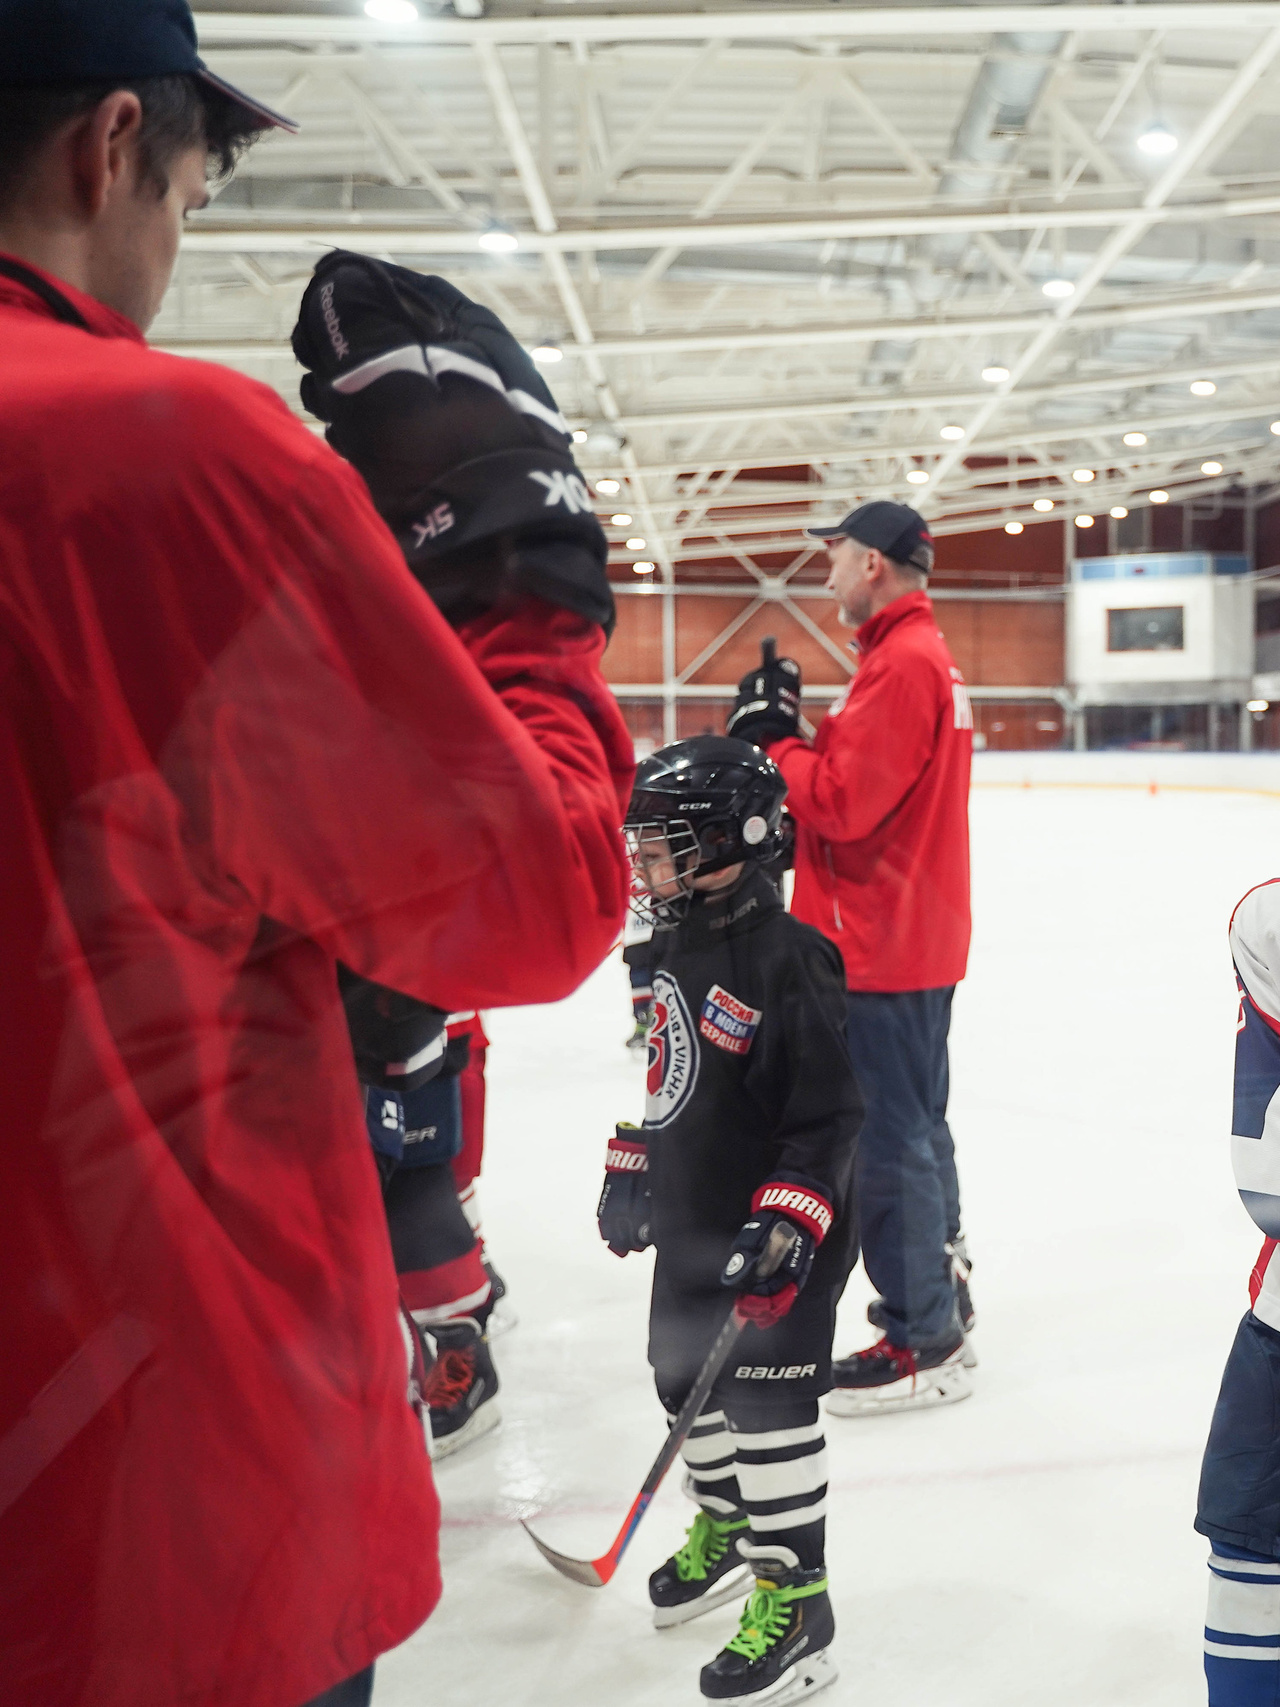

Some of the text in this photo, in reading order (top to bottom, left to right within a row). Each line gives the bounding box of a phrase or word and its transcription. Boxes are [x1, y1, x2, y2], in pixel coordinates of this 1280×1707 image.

[320, 281, 349, 361] Reebok
[678, 801, 712, 811] CCM
[704, 1005, 715, 1020] В
[712, 990, 755, 1022] РОССИЯ
[700, 1019, 743, 1051] СЕРДЦЕ
[734, 1363, 817, 1380] BAUER
